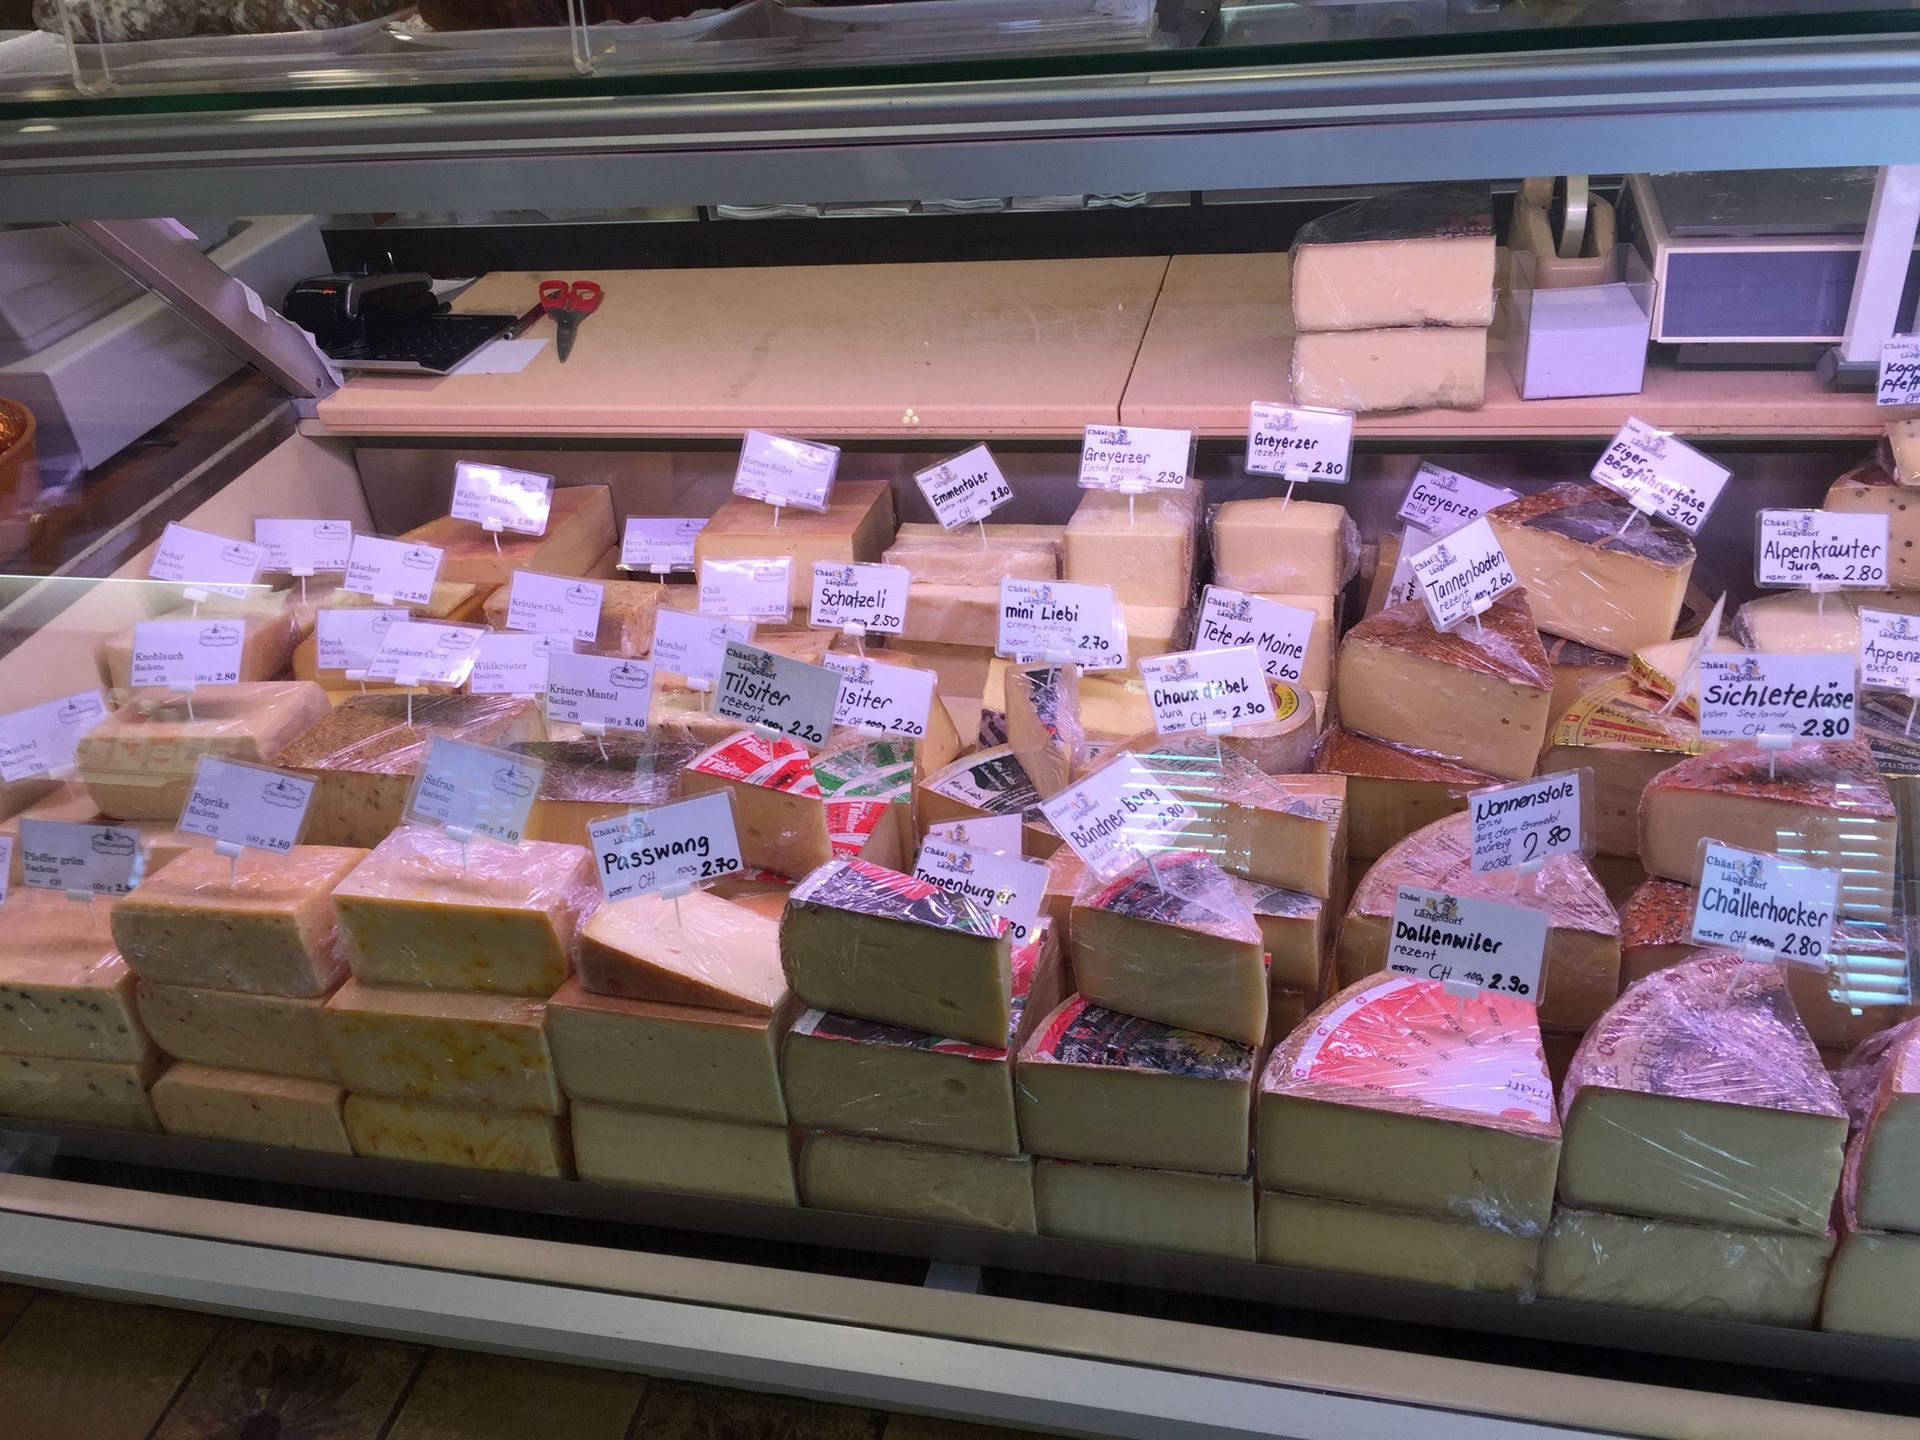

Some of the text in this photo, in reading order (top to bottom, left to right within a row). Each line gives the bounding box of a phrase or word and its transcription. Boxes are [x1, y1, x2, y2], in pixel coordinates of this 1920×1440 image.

[1254, 432, 1318, 452] Greyerzer
[1084, 447, 1151, 468] Greyerzer
[1612, 442, 1648, 465] Eiger
[1273, 460, 1343, 474] CH 2.80
[1156, 472, 1183, 484] 2.90
[805, 491, 822, 502] 2.80
[931, 471, 988, 507] Emmentaler
[959, 486, 1010, 520] CH 2.80
[1406, 502, 1429, 516] mild
[1413, 484, 1479, 520] Greyerze
[1622, 482, 1698, 526] CH 3.10
[1764, 536, 1881, 568] Alpenkräuter
[1787, 560, 1820, 572] Jura
[1843, 565, 1883, 581] 2.80
[1425, 550, 1506, 602] Tannenboden
[1490, 572, 1513, 591] 2.60
[410, 591, 428, 601] 2.80
[702, 586, 721, 595] Chili
[821, 588, 887, 608] Schatzeli
[511, 598, 564, 616] Kräuter-Chili
[768, 604, 785, 613] 2.80
[1439, 588, 1470, 613] rezent
[820, 607, 839, 616] mild
[870, 614, 900, 627] 2.50
[1005, 602, 1079, 622] mini Liebi
[320, 638, 343, 648] Speck
[577, 630, 594, 639] 2.80
[1078, 635, 1109, 650] 2.70
[1203, 619, 1232, 645] Tete
[1257, 632, 1303, 659] Moine
[656, 638, 688, 652] Morchel
[135, 651, 184, 662] Knoblauch
[474, 661, 528, 671] Wildkräuter
[1266, 660, 1299, 680] 2.60
[1866, 662, 1898, 673] extra
[216, 672, 236, 681] 2.80
[1719, 674, 1767, 682] Längedorf
[550, 683, 618, 701] Kräuter-Mantel
[725, 671, 791, 707] Tilsiter
[840, 687, 893, 709] lsiter
[1154, 685, 1199, 707] Chaux
[1704, 681, 1854, 710] Sichletekäse
[722, 695, 766, 714] rezent
[568, 711, 579, 720] CH
[625, 717, 645, 728] 3.40
[1159, 708, 1183, 720] Jura
[1190, 702, 1265, 727] CH 2.90
[1702, 709, 1788, 719] vom Seeland
[788, 720, 823, 743] 2.20
[891, 718, 923, 735] 2.20
[1742, 723, 1766, 737] CH
[1800, 717, 1850, 738] 2.80
[424, 773, 455, 792] Safran
[193, 792, 230, 810] Paprika
[1475, 782, 1574, 823] Nonnenstolz
[1158, 803, 1185, 826] 2.80
[206, 824, 219, 833] CH
[268, 837, 290, 850] 2.80
[592, 825, 620, 838] Chäsi
[1070, 809, 1126, 849] Bündner
[1475, 826, 1518, 843] aus dem
[924, 846, 948, 858] Chäsi
[1523, 825, 1571, 863] 2.80
[24, 851, 85, 866] Pfeffer grün
[603, 835, 710, 875] Passwang
[1706, 856, 1736, 870] Chäsi
[638, 871, 656, 890] CH
[700, 857, 738, 878] 2.70
[1721, 872, 1768, 890] Längedorf
[115, 883, 133, 893] 2.8
[1702, 886, 1829, 928] Chällerhocker
[1414, 908, 1464, 926] Längedorf
[1396, 920, 1503, 955] Dallenwiler
[1730, 930, 1822, 957] CH 2.80
[1394, 943, 1437, 961] rezent
[1428, 964, 1530, 995] CH 100g 2.90
